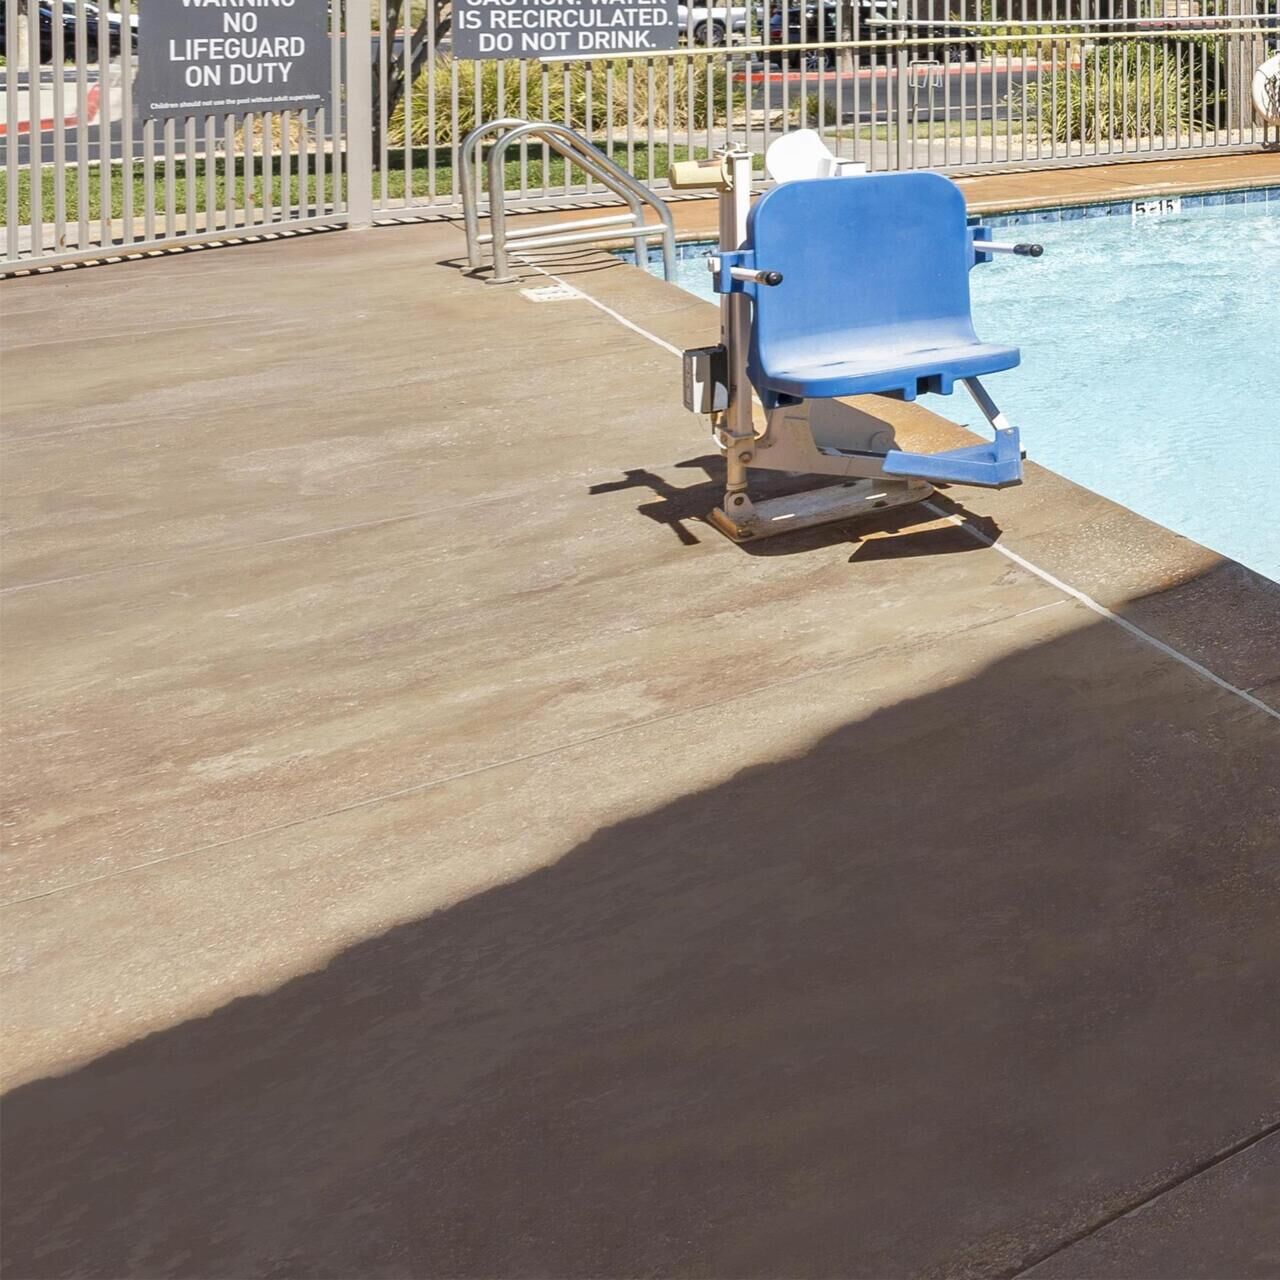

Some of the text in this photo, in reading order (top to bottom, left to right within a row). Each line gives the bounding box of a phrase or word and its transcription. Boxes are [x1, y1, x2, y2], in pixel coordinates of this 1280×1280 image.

[223, 11, 258, 33] NO
[459, 8, 674, 30] IS RECIRCULATED.
[169, 36, 306, 62] LIFEGUARD
[478, 30, 657, 53] DO NOT DRINK.
[185, 61, 293, 87] ON DUTY
